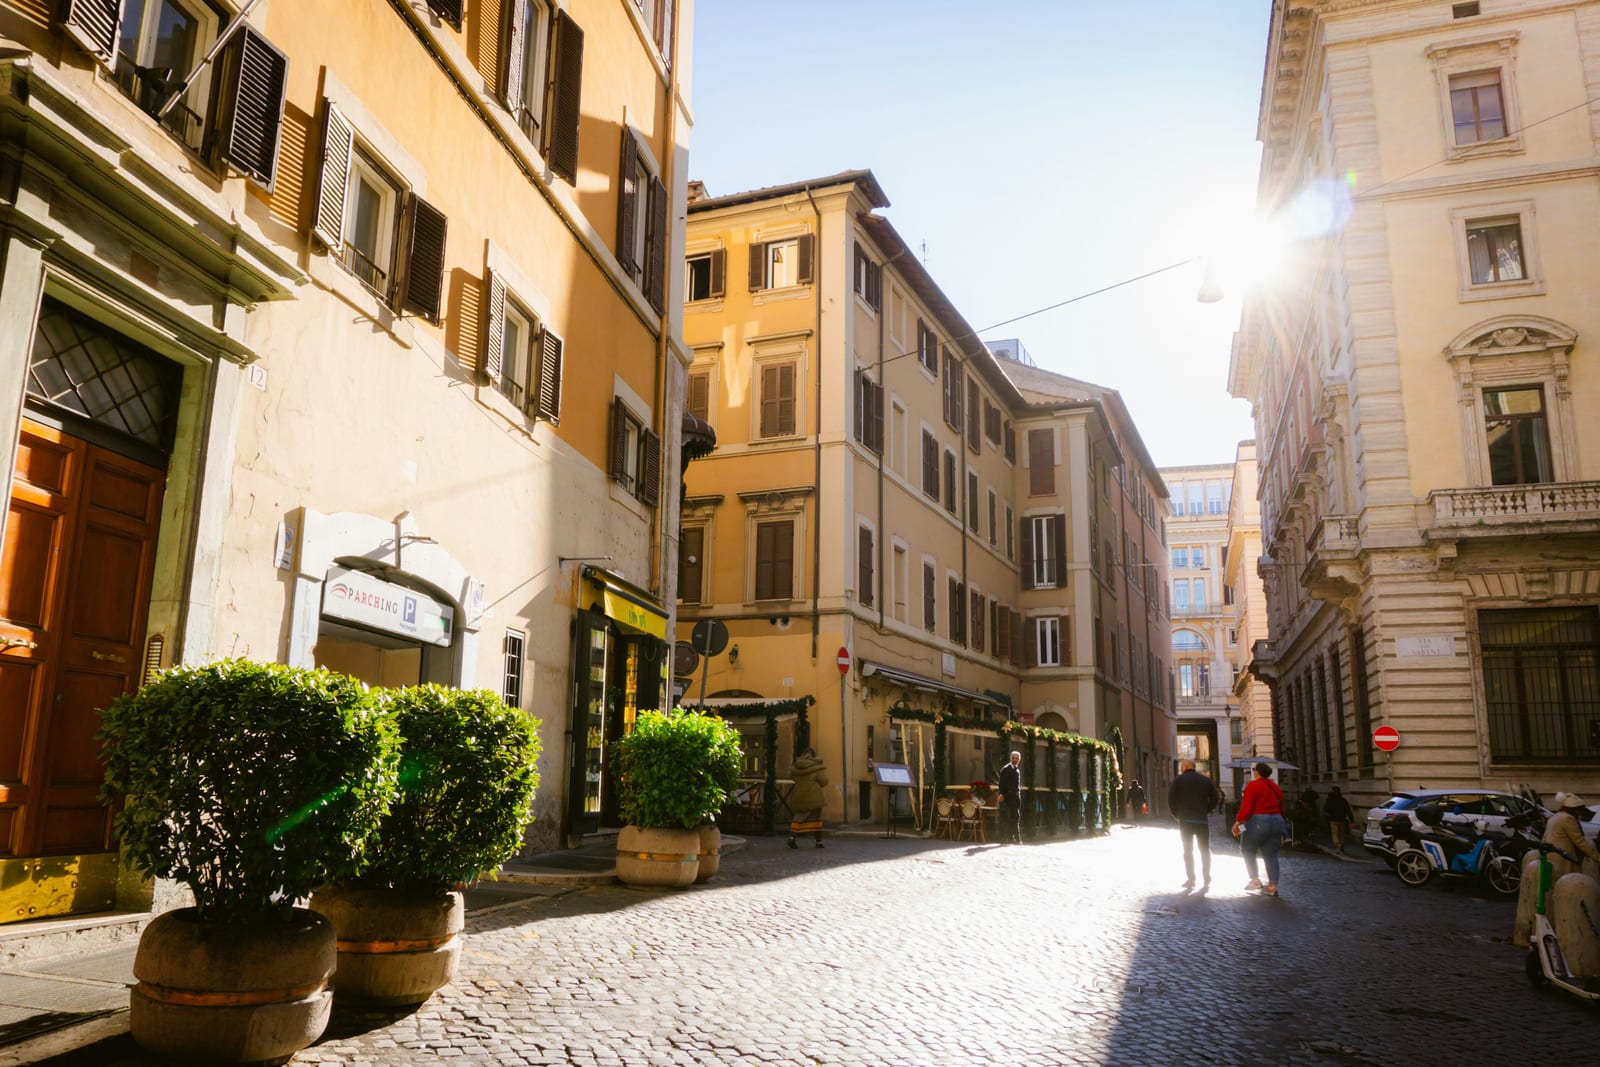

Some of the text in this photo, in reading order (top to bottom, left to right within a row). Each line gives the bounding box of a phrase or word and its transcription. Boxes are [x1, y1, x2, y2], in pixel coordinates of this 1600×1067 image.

[250, 365, 264, 388] 12
[348, 587, 399, 615] PARCHING
[404, 598, 415, 621] P
